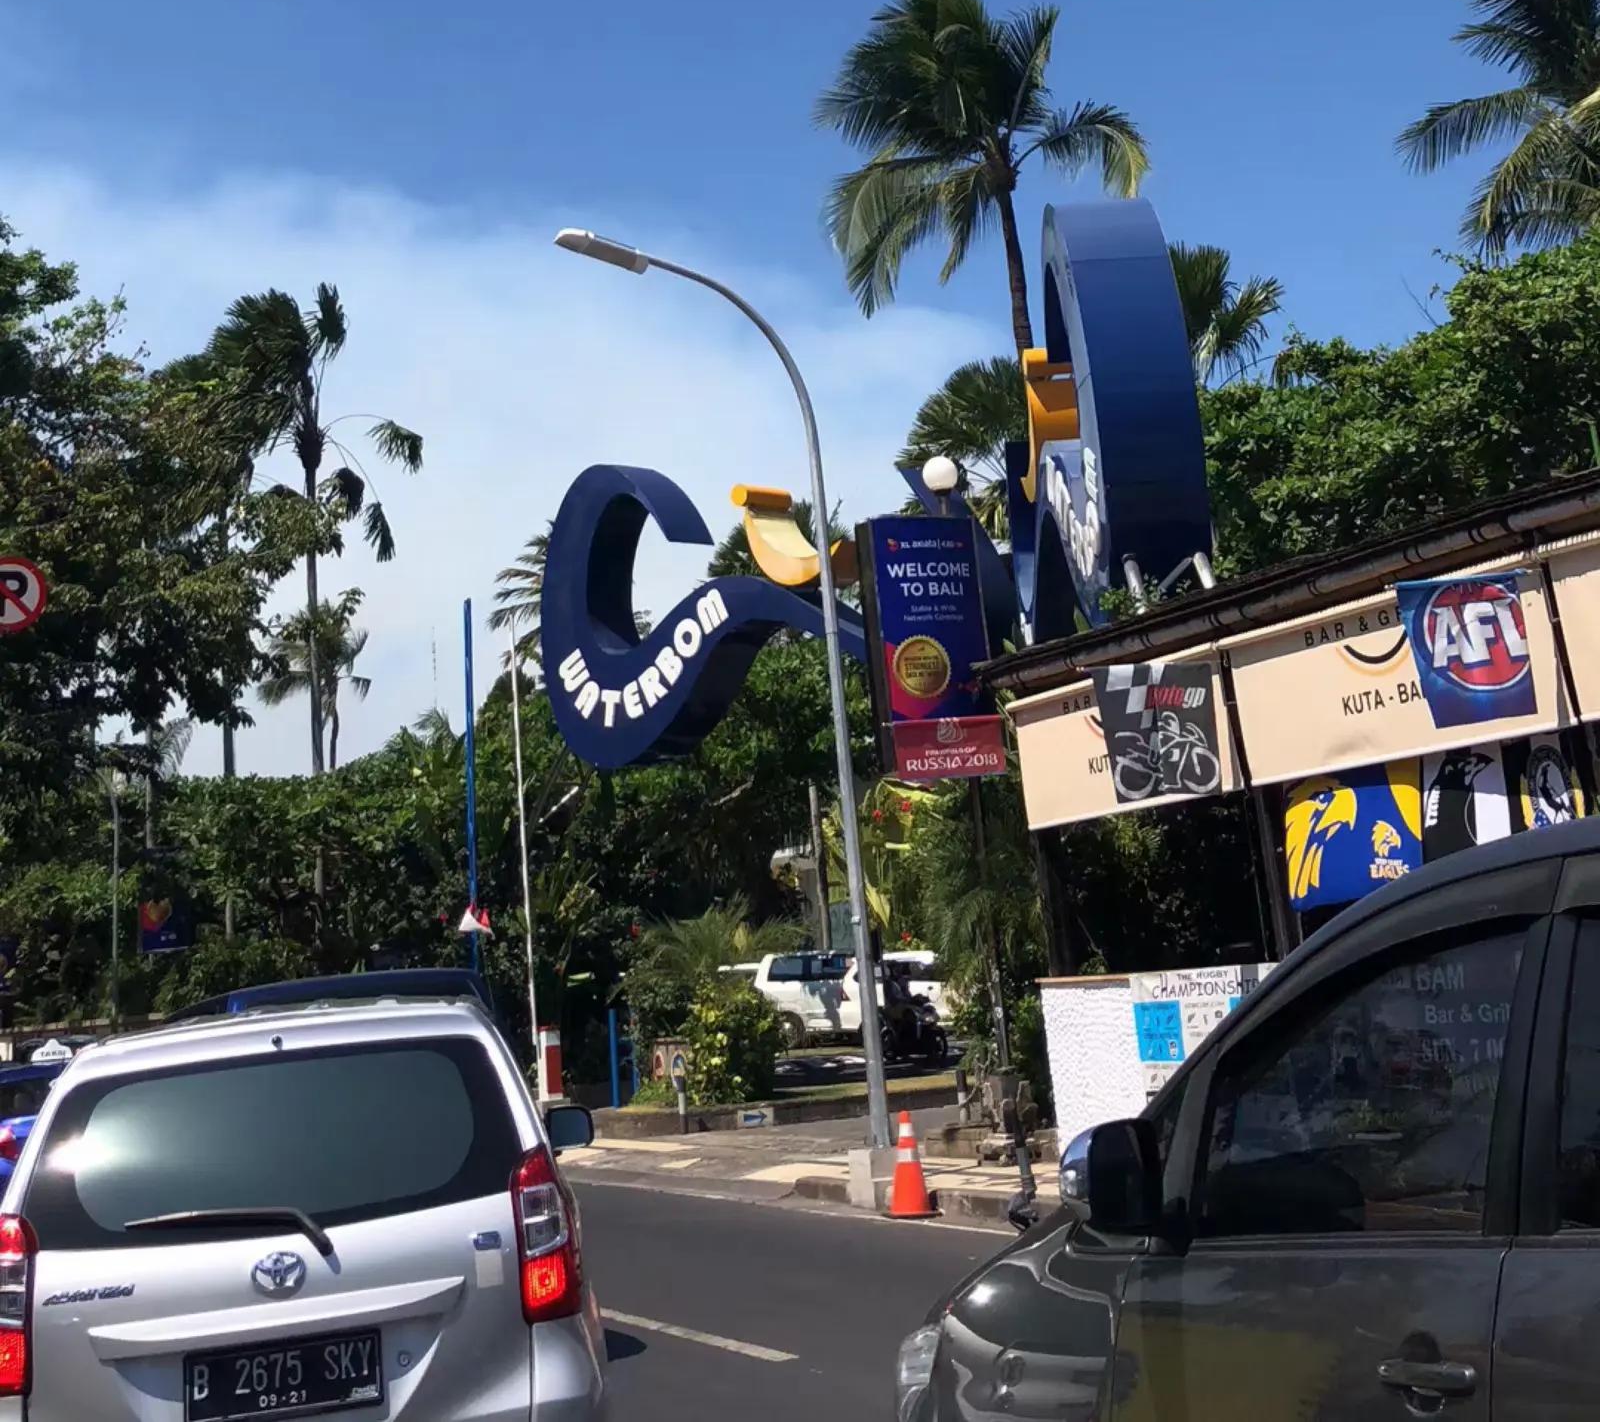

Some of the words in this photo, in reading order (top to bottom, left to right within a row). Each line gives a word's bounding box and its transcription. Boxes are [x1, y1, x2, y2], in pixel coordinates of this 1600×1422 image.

[886, 562, 970, 578] WELCOME
[900, 581, 924, 597] TO
[928, 581, 964, 596] BALI
[1304, 622, 1345, 646] BAR
[1358, 615, 1369, 632] &
[1432, 596, 1529, 669] AFL
[558, 587, 729, 727] WATERBOM
[1062, 695, 1092, 714] BAR
[1341, 688, 1385, 716] KUTA
[906, 756, 962, 772] RUSSIA
[965, 753, 998, 767] 2018
[1424, 1004, 1454, 1024] Bar
[1460, 1003, 1473, 1023] &
[193, 1365, 209, 1400] B
[235, 1350, 302, 1395] 2675
[324, 1340, 371, 1380] SKY
